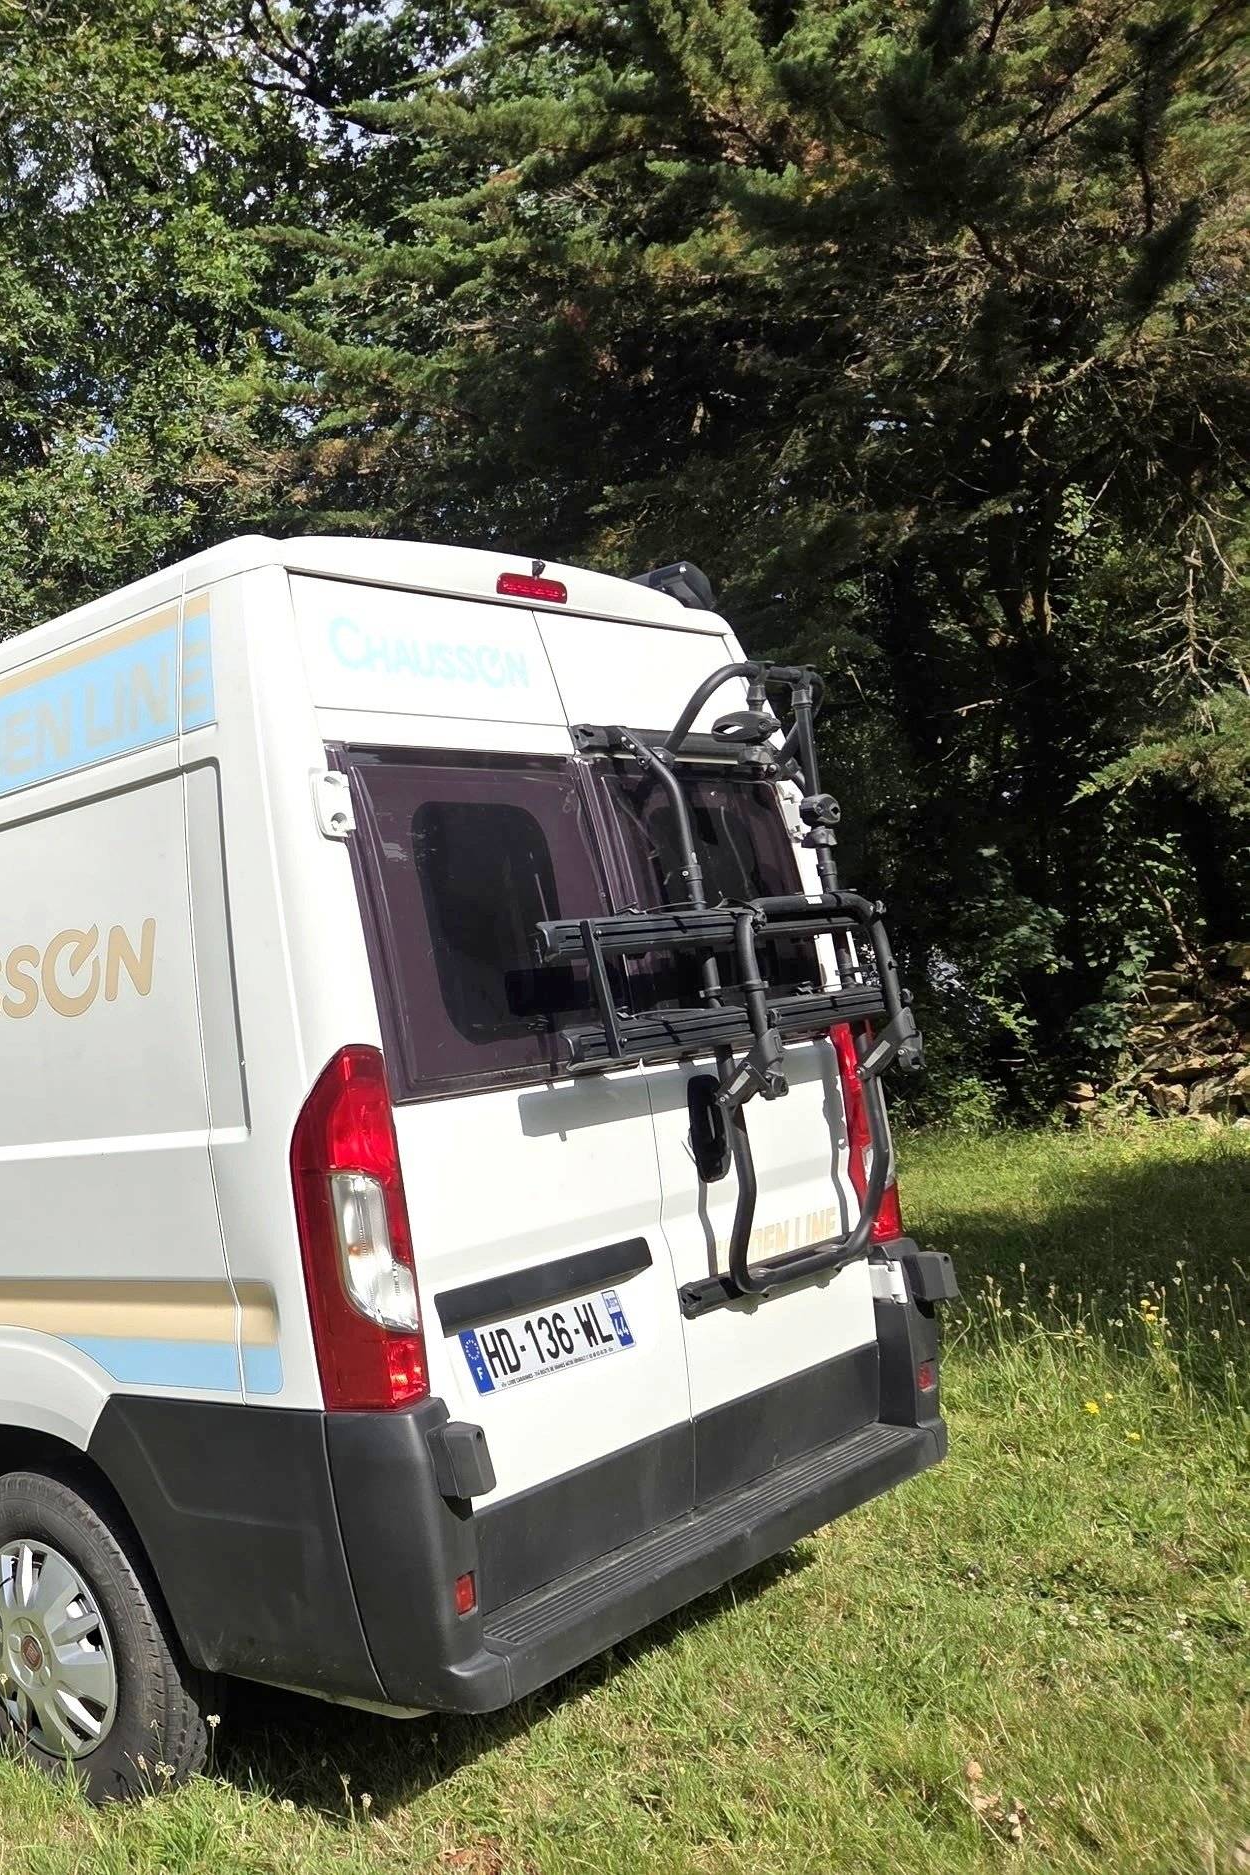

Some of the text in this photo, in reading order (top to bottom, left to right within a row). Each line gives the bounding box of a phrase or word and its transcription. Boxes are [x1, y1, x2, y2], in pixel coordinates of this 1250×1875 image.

[329, 616, 530, 689] CHAUSSON
[479, 1302, 614, 1379] HD-136-WL
[614, 1316, 630, 1337] 44
[476, 1366, 485, 1382] F
